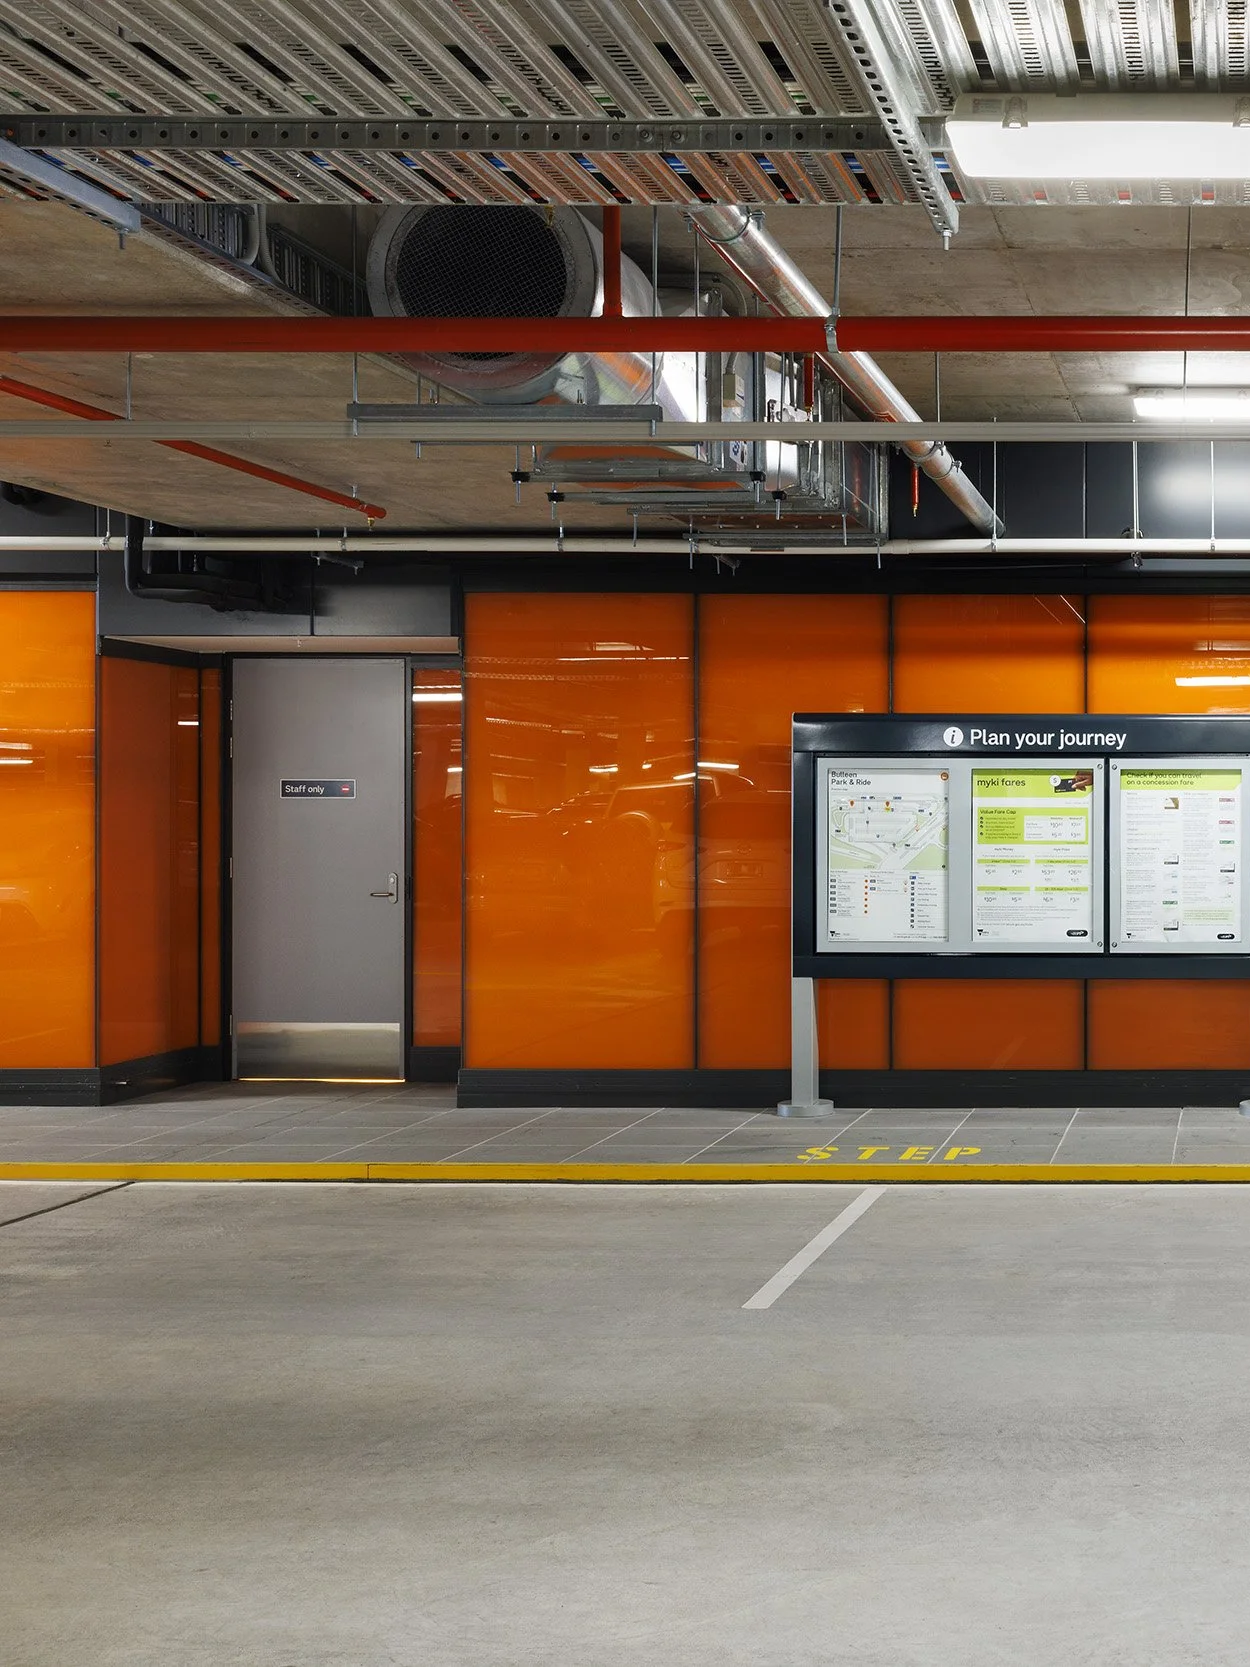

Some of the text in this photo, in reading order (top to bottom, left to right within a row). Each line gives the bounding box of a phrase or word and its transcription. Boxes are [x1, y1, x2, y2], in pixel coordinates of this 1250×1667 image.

[970, 729, 1127, 750] Plan your journey
[831, 770, 858, 778] Bulleen
[977, 778, 1026, 788] myki fares
[285, 784, 325, 795] Staff only
[796, 1146, 982, 1160] STEP
